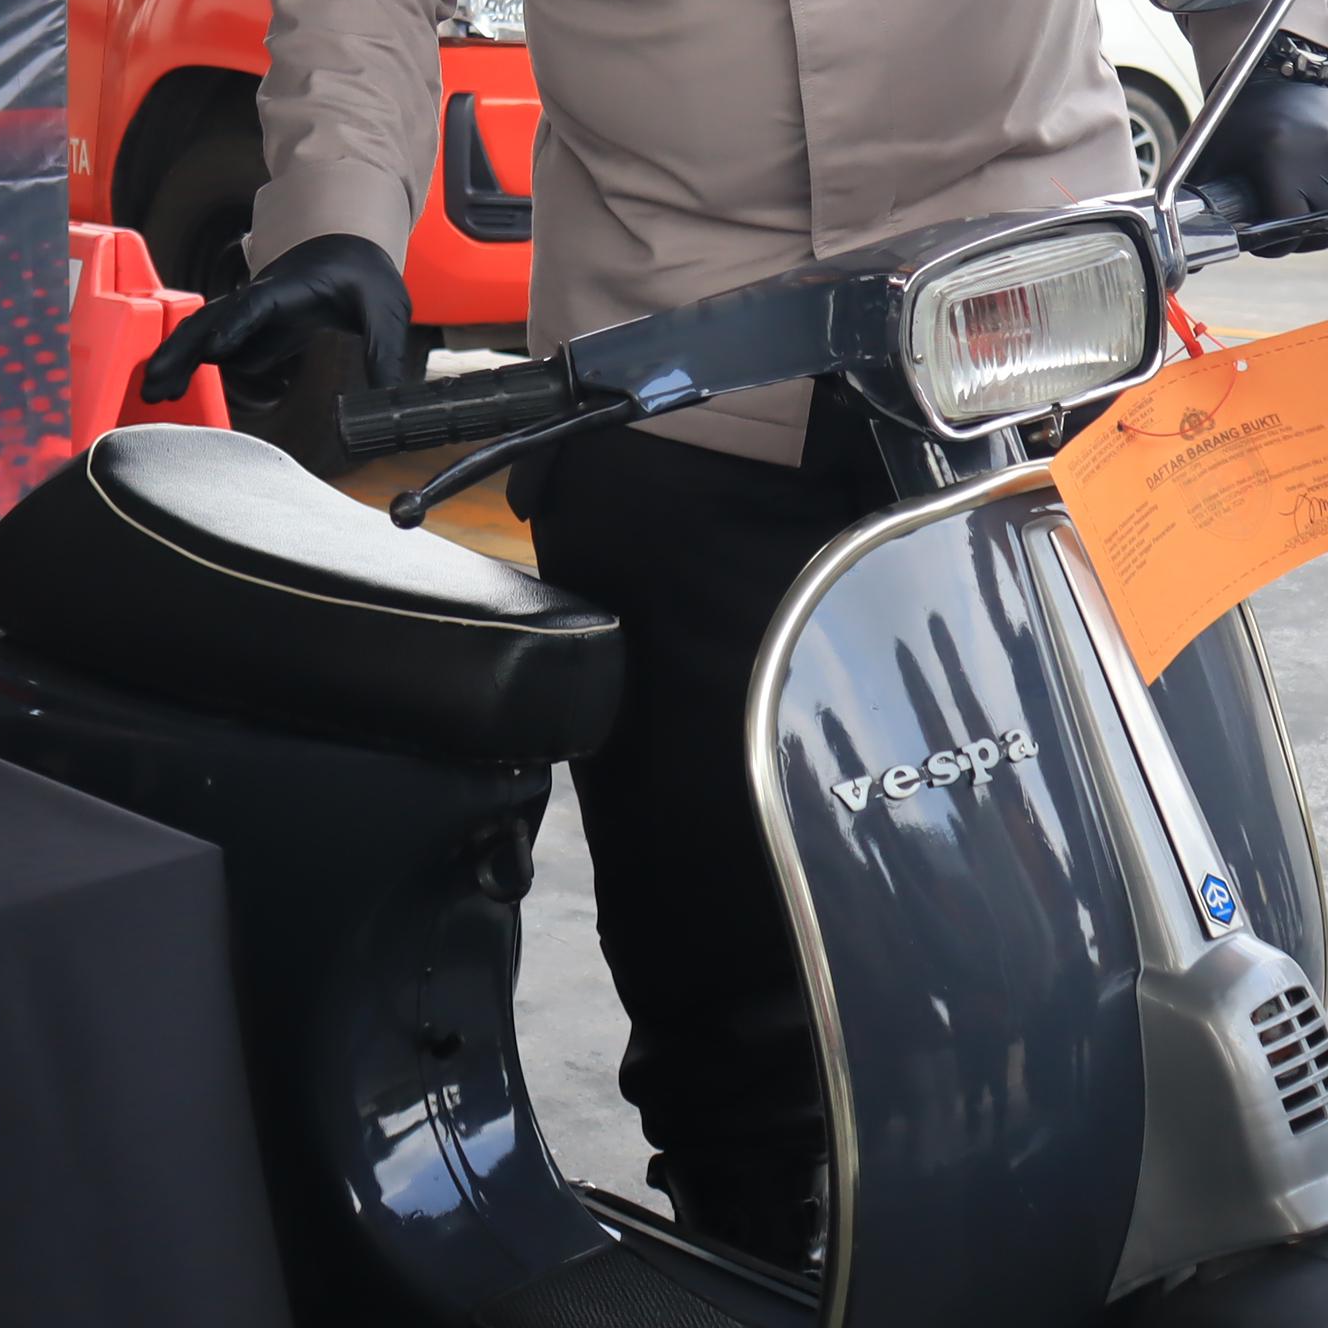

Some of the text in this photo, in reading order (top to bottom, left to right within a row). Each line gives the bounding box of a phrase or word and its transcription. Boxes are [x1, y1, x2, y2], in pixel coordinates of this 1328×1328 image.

[1146, 453, 1186, 491] DAFTAR
[1186, 427, 1241, 460] BARANG
[1241, 412, 1281, 436] BUKTI
[832, 728, 1039, 811] vespa
